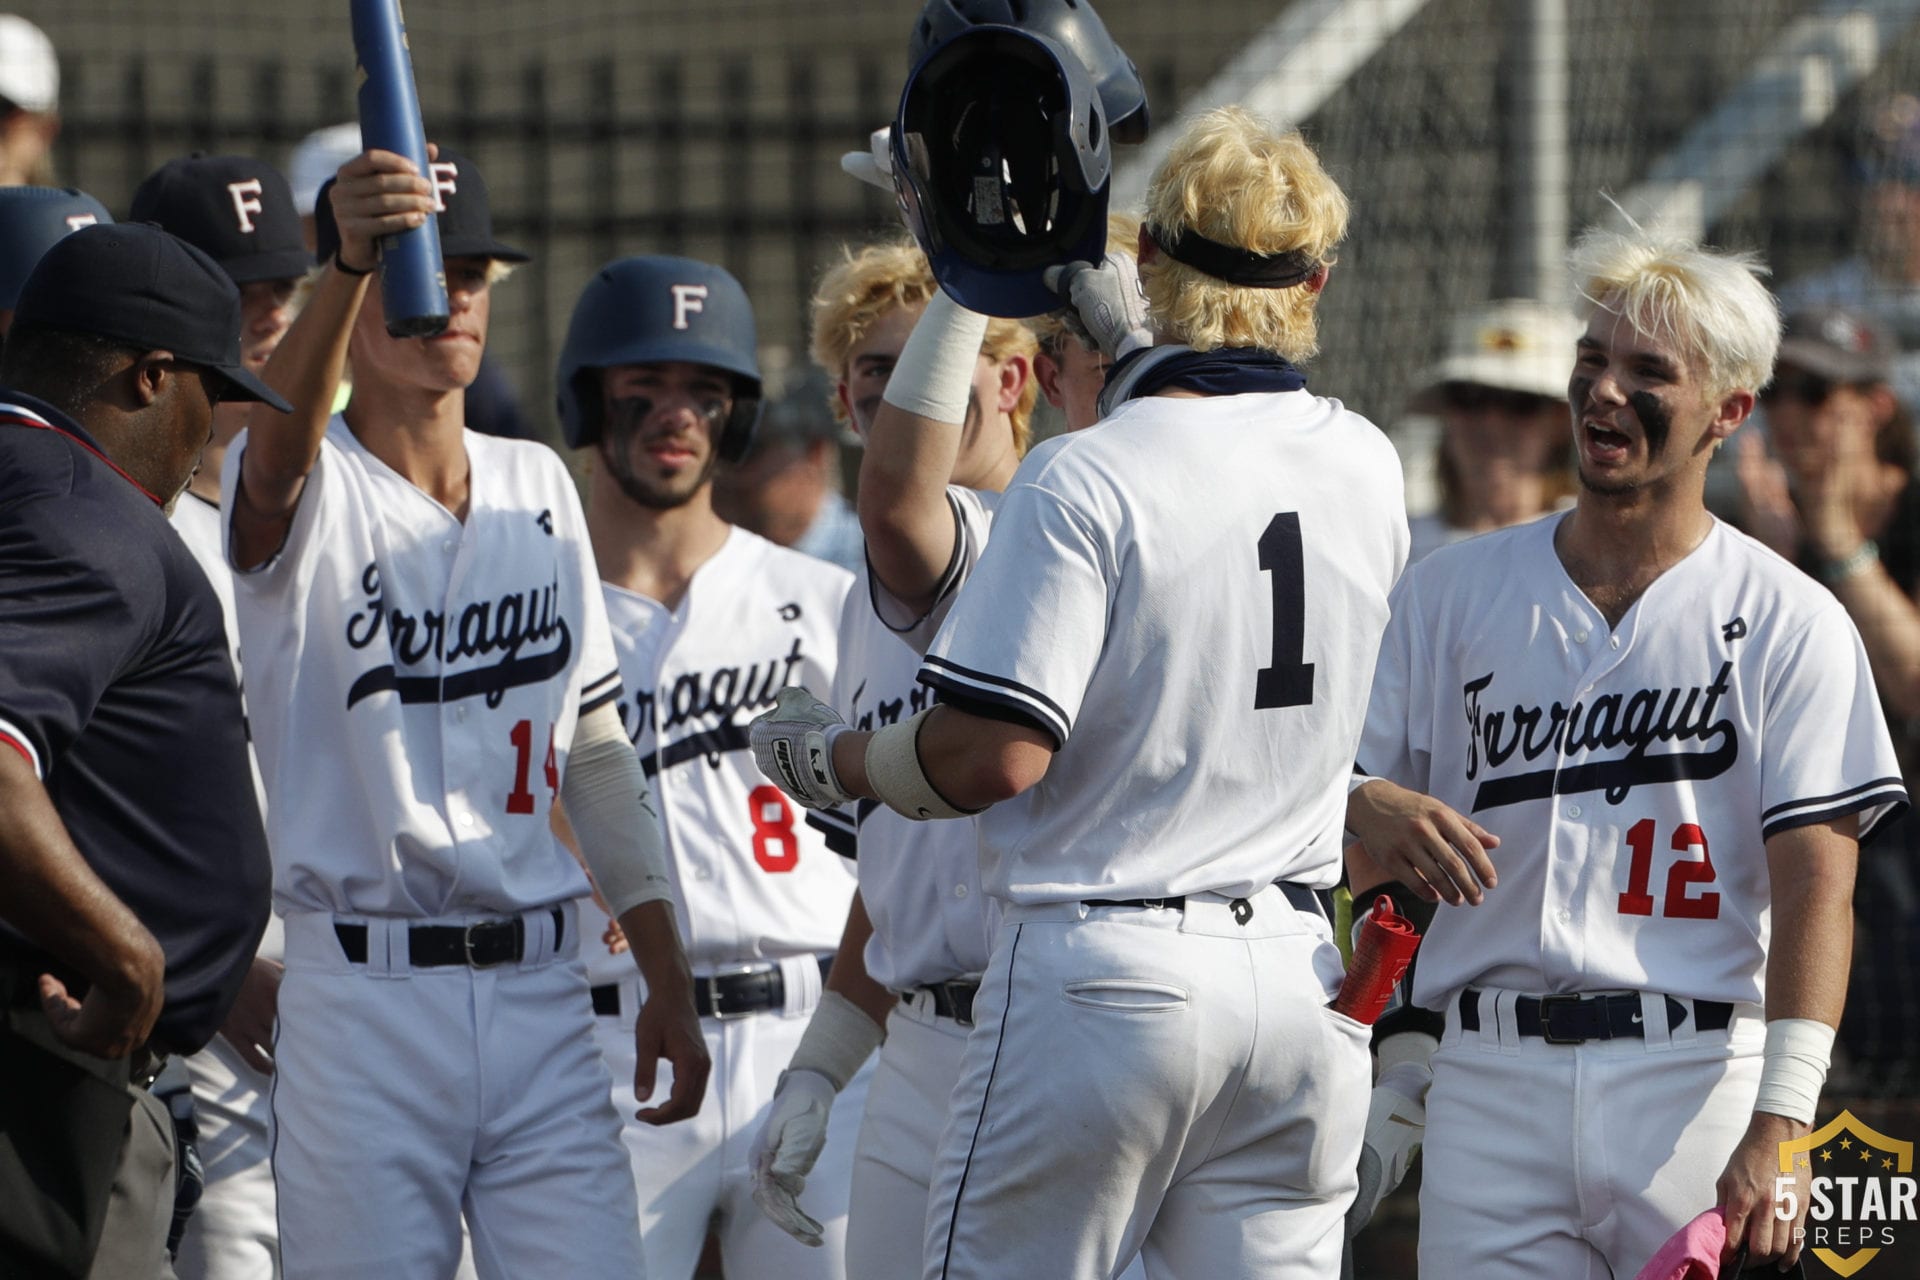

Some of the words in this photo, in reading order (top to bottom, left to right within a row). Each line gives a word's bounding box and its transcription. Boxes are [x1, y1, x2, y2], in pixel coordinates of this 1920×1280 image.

[227, 178, 263, 233] F
[428, 162, 459, 212] F
[671, 284, 708, 330] F
[1254, 511, 1315, 709] 1
[1463, 660, 1738, 806] Farragut
[747, 785, 800, 873] 8
[1617, 818, 1721, 920] 12
